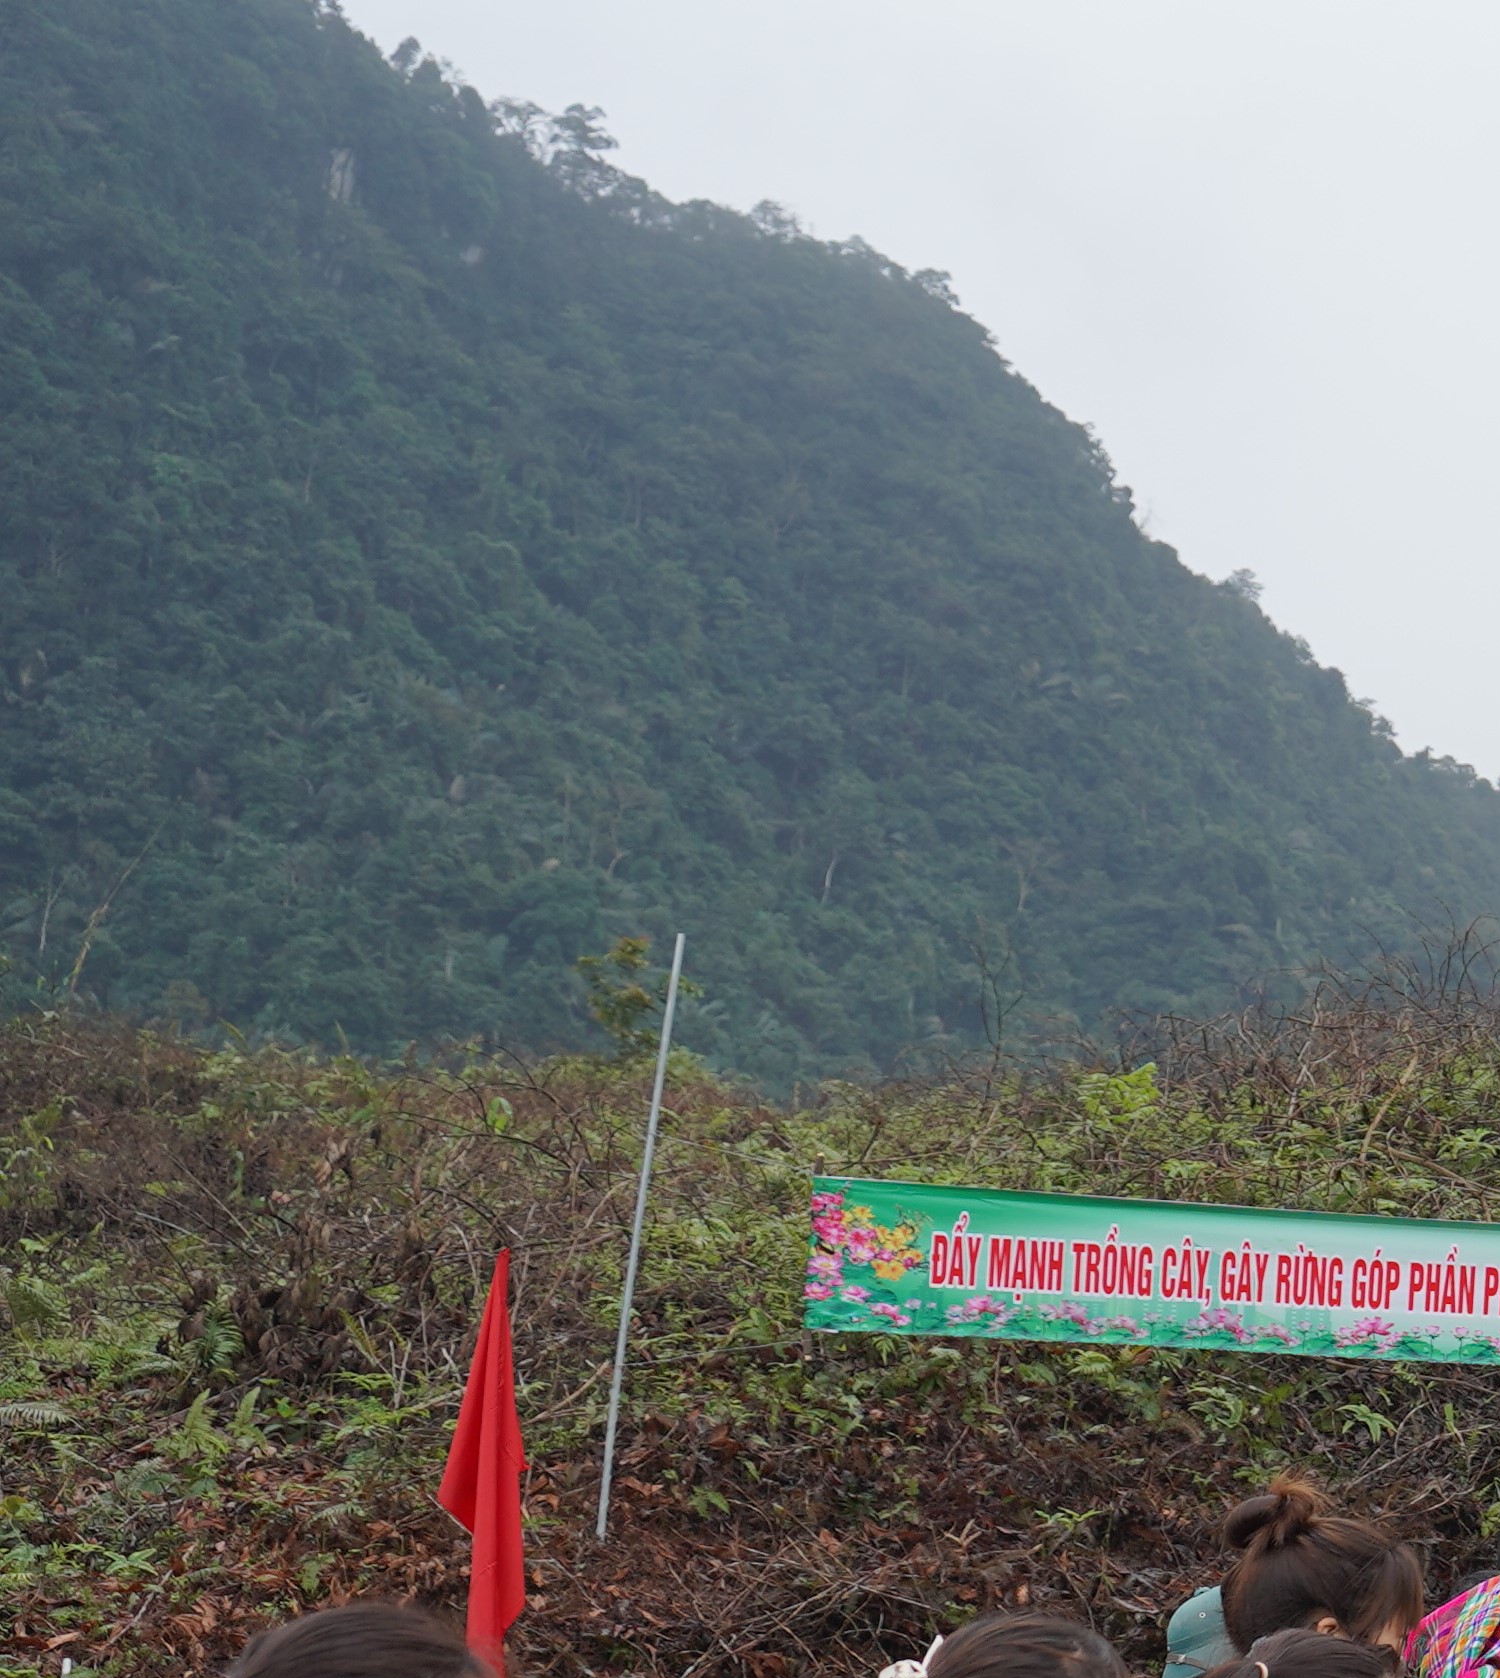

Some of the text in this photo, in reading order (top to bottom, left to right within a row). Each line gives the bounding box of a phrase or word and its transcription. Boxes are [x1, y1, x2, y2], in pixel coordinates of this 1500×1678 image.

[932, 1214, 982, 1286] ĐẨY
[989, 1238, 1064, 1301] MẠNH
[1073, 1227, 1152, 1296] TRỒNG
[1161, 1238, 1211, 1305] CÂY,
[1221, 1241, 1268, 1303] GÂY
[1276, 1245, 1343, 1307] RỪNG
[1351, 1250, 1400, 1310] GÓP
[1408, 1247, 1476, 1315] PHẦN
